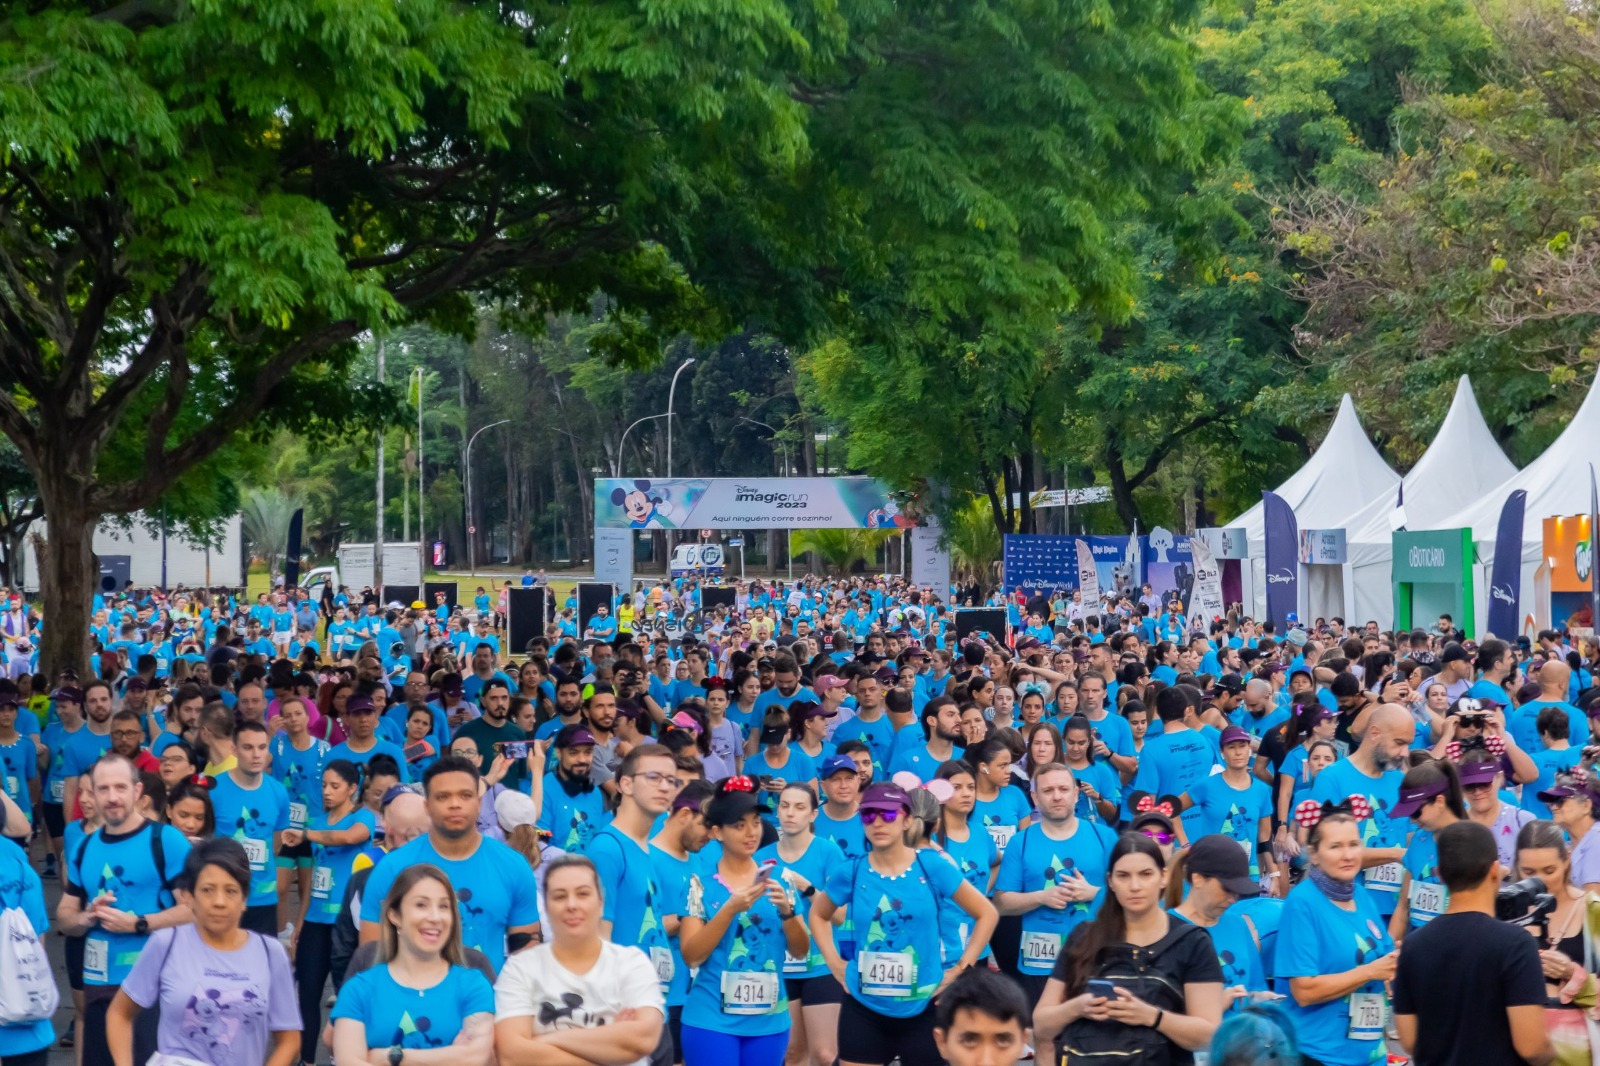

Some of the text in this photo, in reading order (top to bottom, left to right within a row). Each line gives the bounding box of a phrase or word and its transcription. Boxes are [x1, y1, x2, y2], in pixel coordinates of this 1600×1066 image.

[734, 485, 758, 494] Disney
[290, 809, 301, 820] 37
[1373, 865, 1397, 881] 7365
[1029, 942, 1056, 958] 7044
[870, 964, 904, 983] 4348
[733, 984, 764, 1002] 4314
